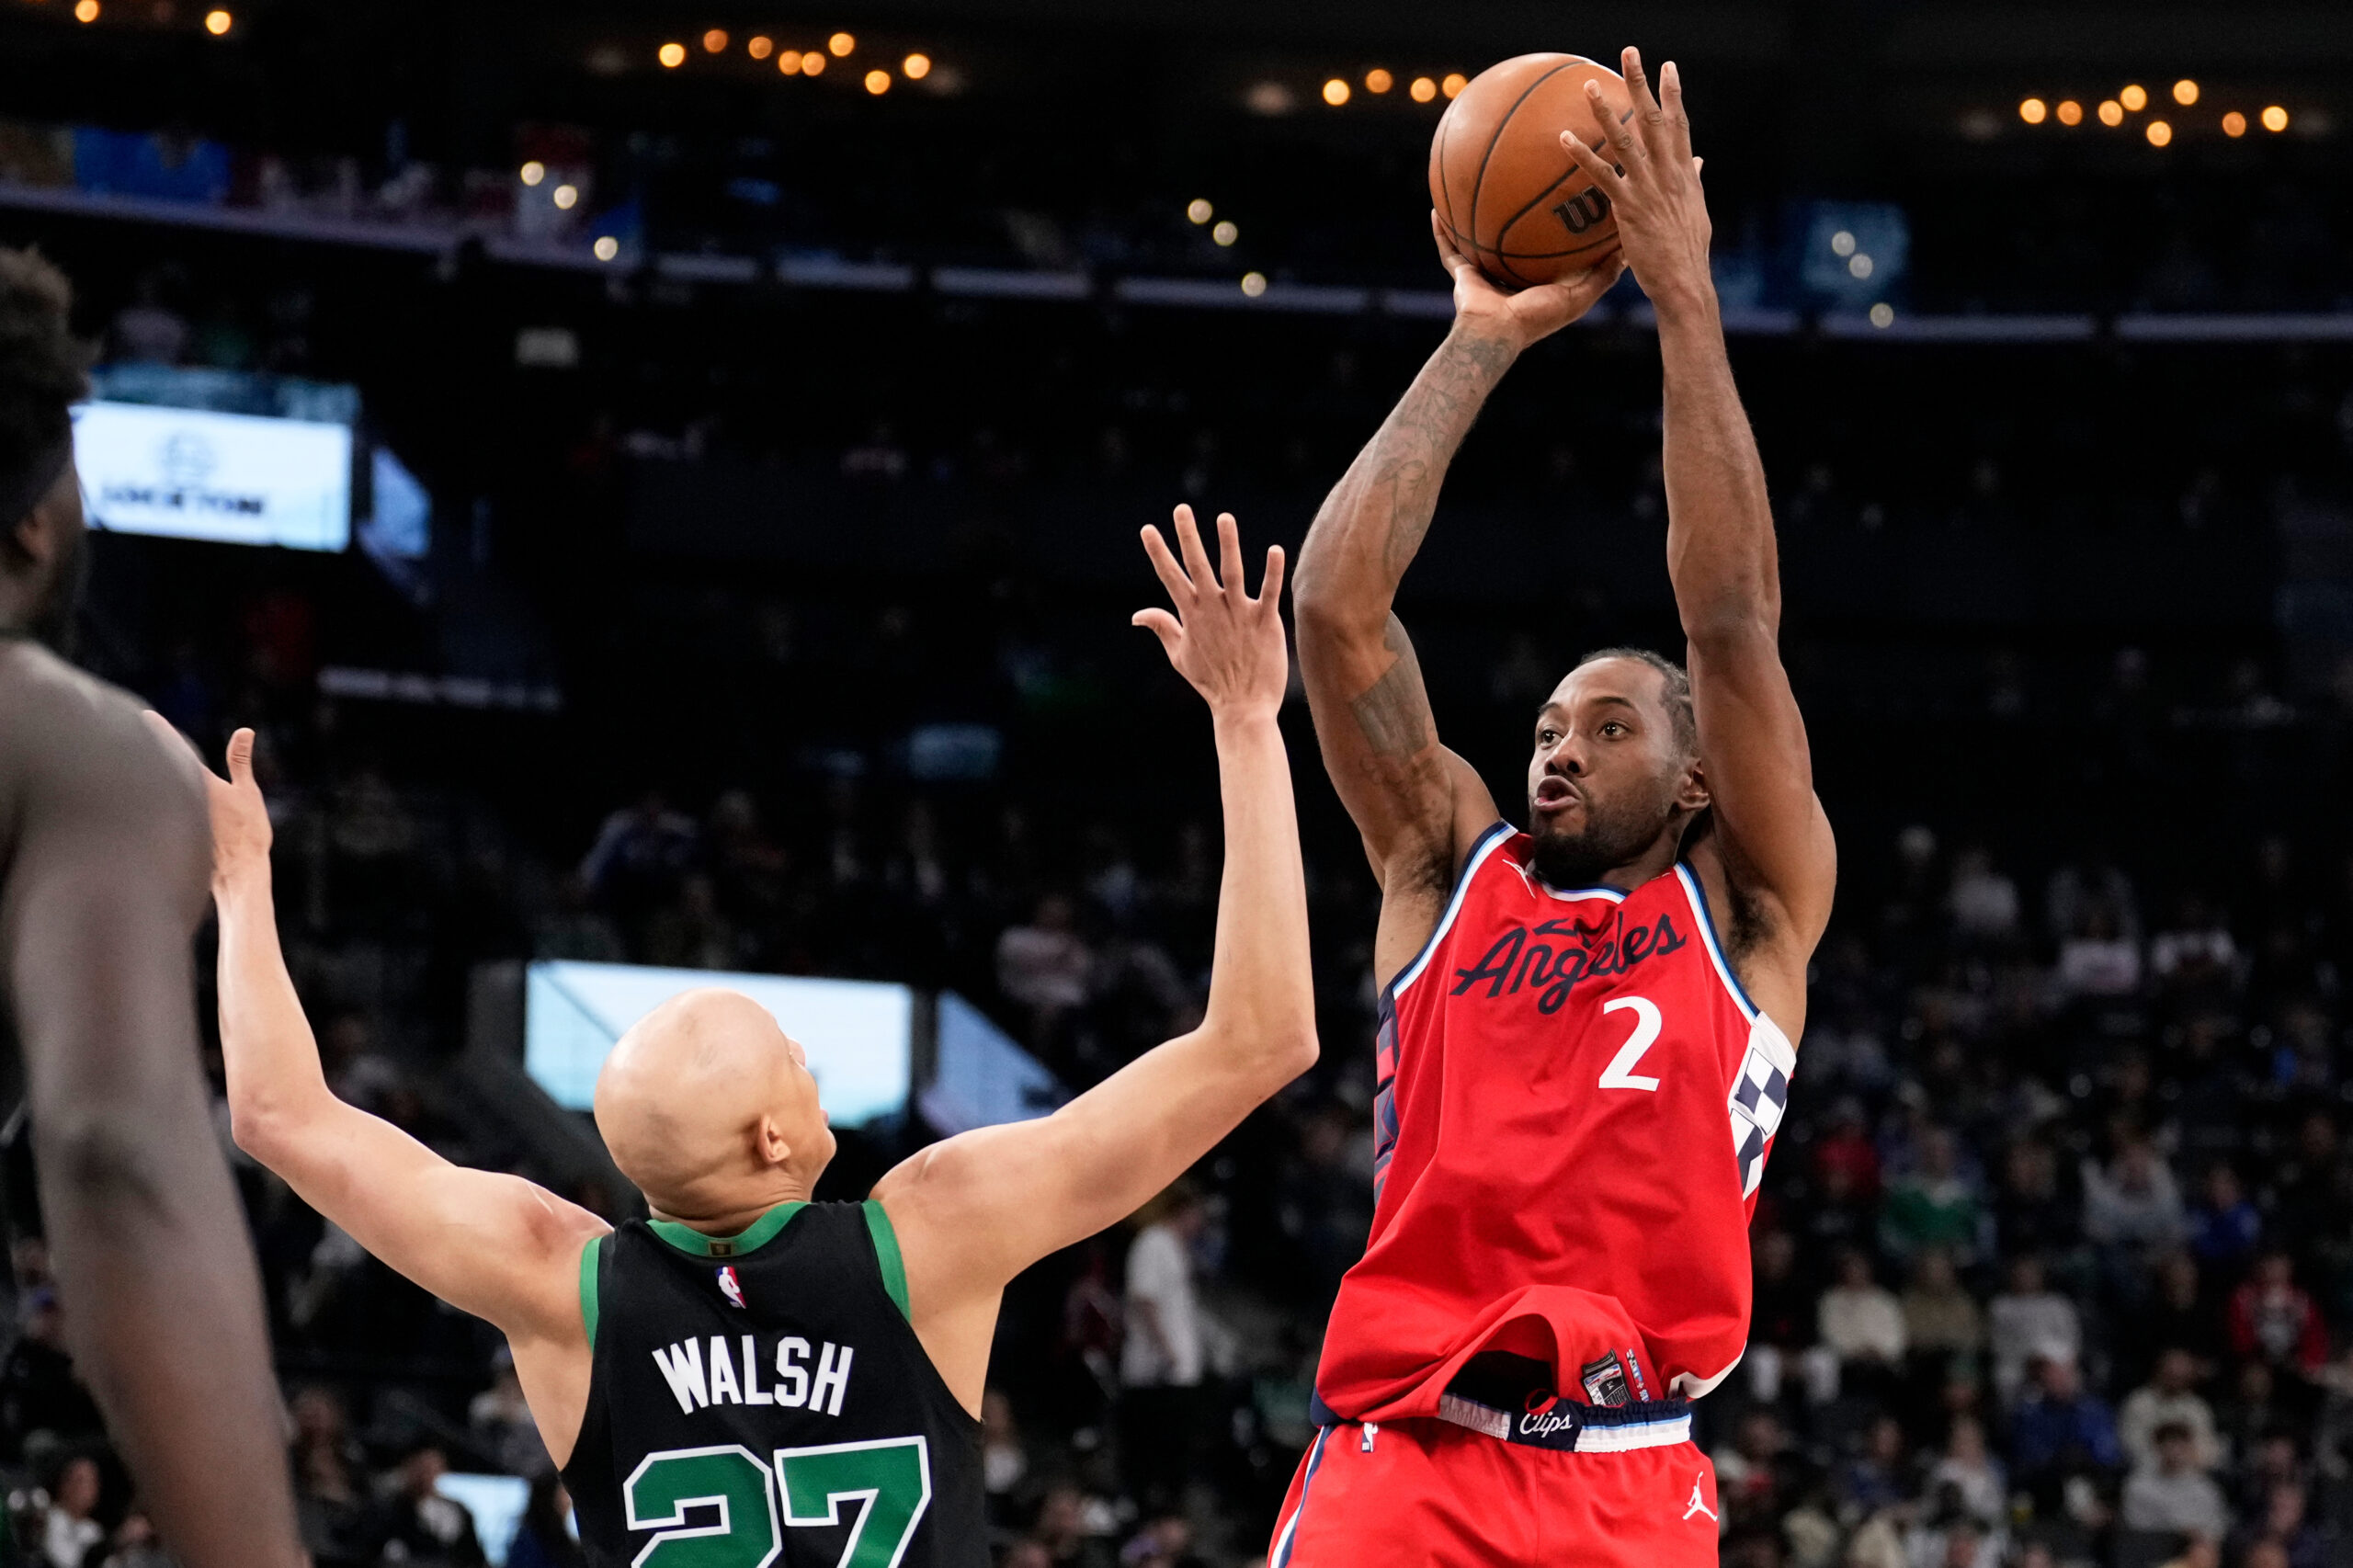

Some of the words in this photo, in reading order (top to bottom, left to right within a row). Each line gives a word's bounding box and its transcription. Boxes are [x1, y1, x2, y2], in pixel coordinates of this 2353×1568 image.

[1449, 911, 1688, 1015] Angeles
[1598, 995, 1662, 1091] 2
[652, 1335, 854, 1416] WALSH
[1519, 1411, 1573, 1438] Clips
[623, 1436, 932, 1568] 27
